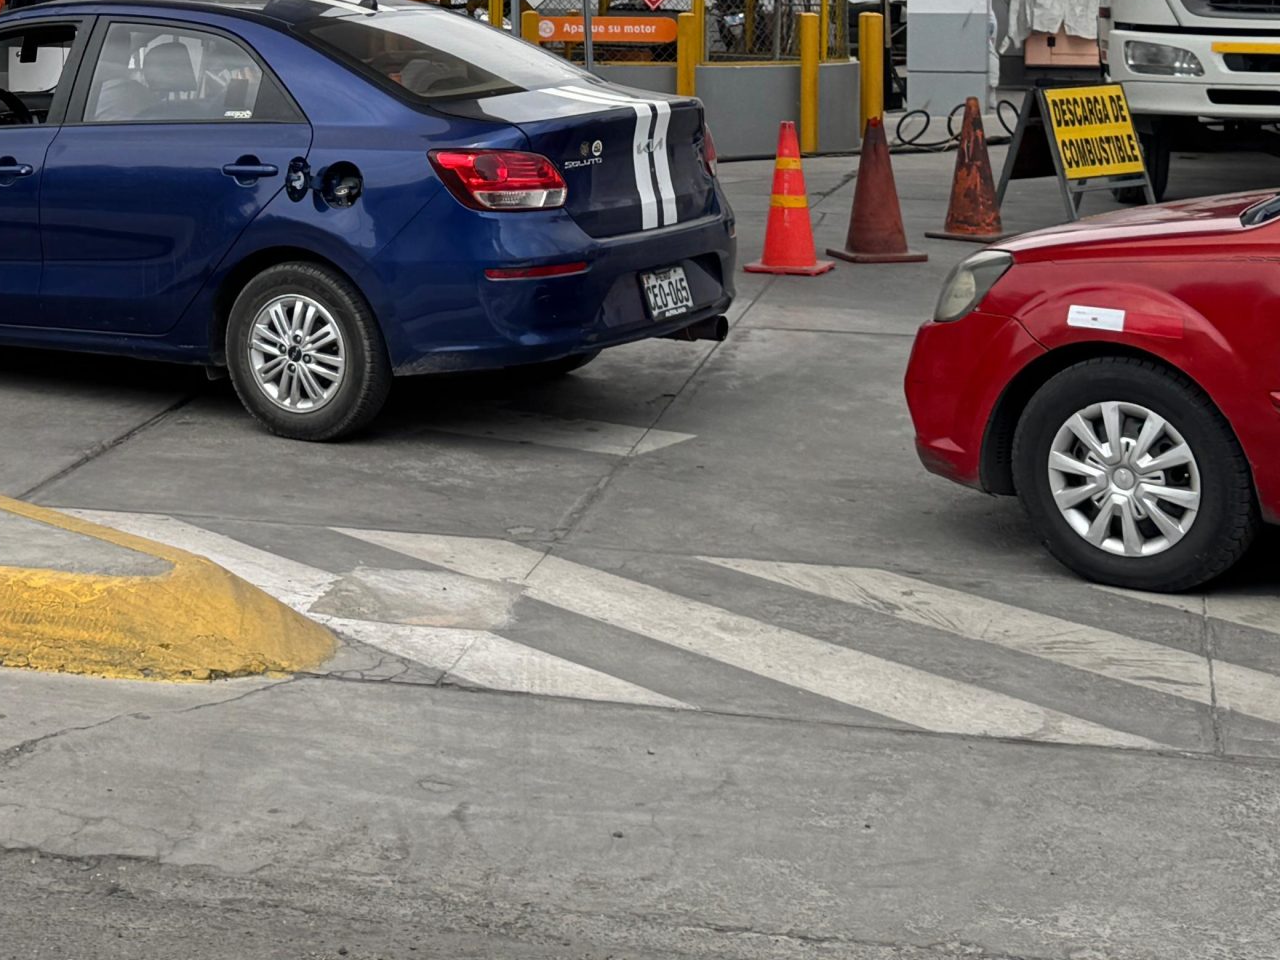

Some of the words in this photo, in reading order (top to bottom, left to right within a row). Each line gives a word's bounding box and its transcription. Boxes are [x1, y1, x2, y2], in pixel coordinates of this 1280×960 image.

[563, 22, 605, 36] Apaue
[608, 25, 621, 33] su
[624, 23, 657, 33] motor
[1051, 95, 1111, 127] DESCARGA
[1108, 94, 1127, 122] DE
[564, 157, 603, 169] SOLUTO
[1061, 134, 1139, 169] COMBUSTIBLE
